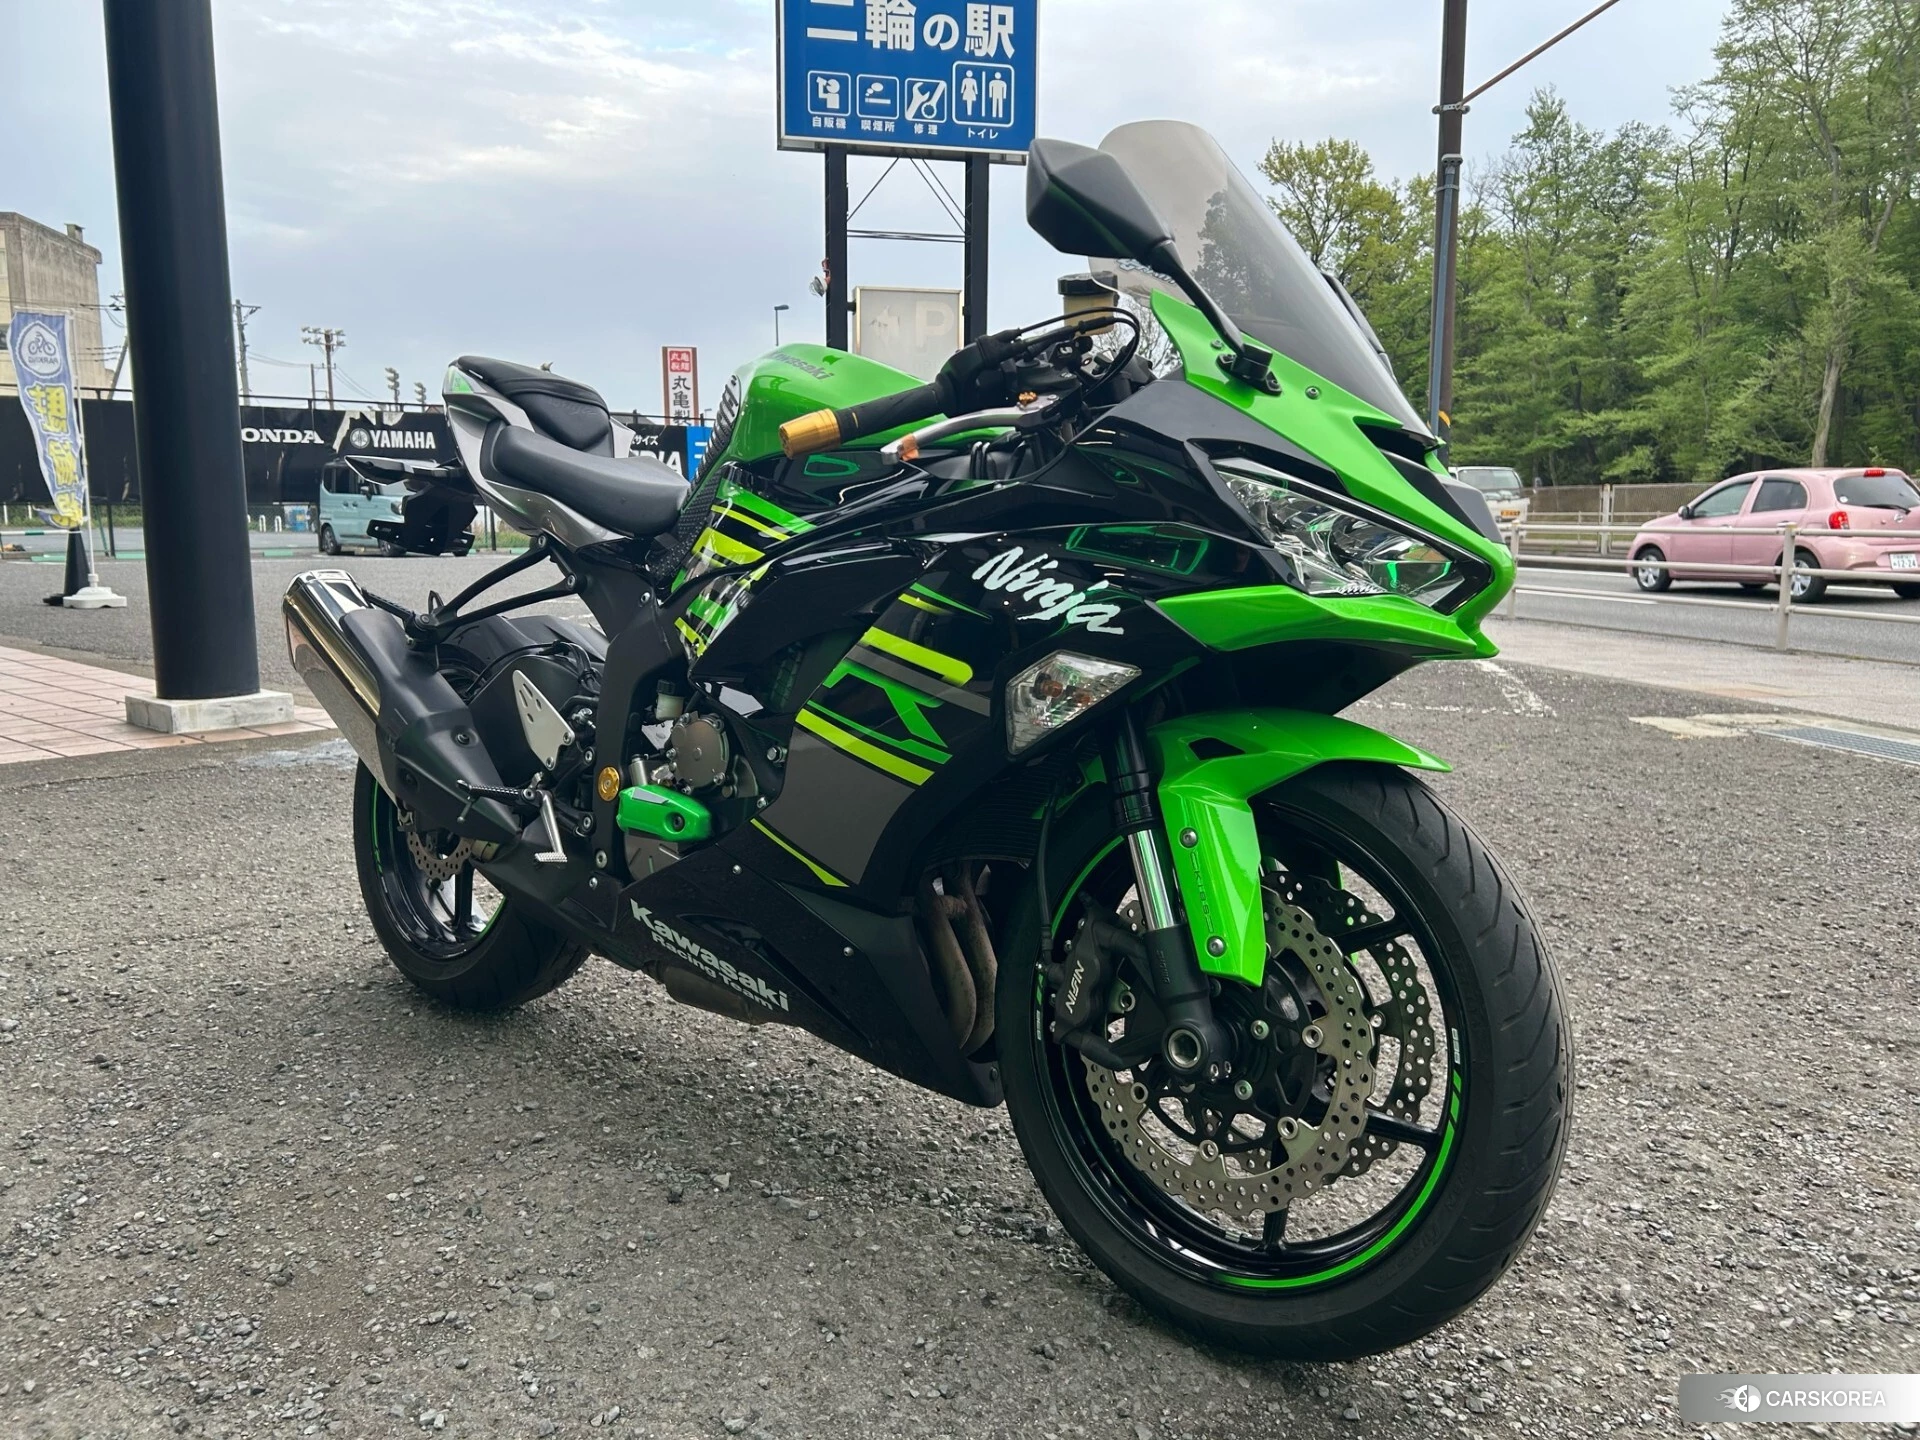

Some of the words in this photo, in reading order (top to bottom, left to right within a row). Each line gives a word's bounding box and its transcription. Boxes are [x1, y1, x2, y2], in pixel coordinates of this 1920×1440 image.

[806, 0, 1015, 58] 二輪の駅
[811, 116, 846, 130] 自販機
[860, 119, 896, 133] 喫煙所
[966, 127, 999, 139] トイレ
[369, 429, 436, 450] YAMAHA
[971, 546, 1125, 635] Ninja
[630, 898, 789, 1012] Kawasaki
[651, 931, 717, 979] Racing
[719, 972, 774, 1011] Team
